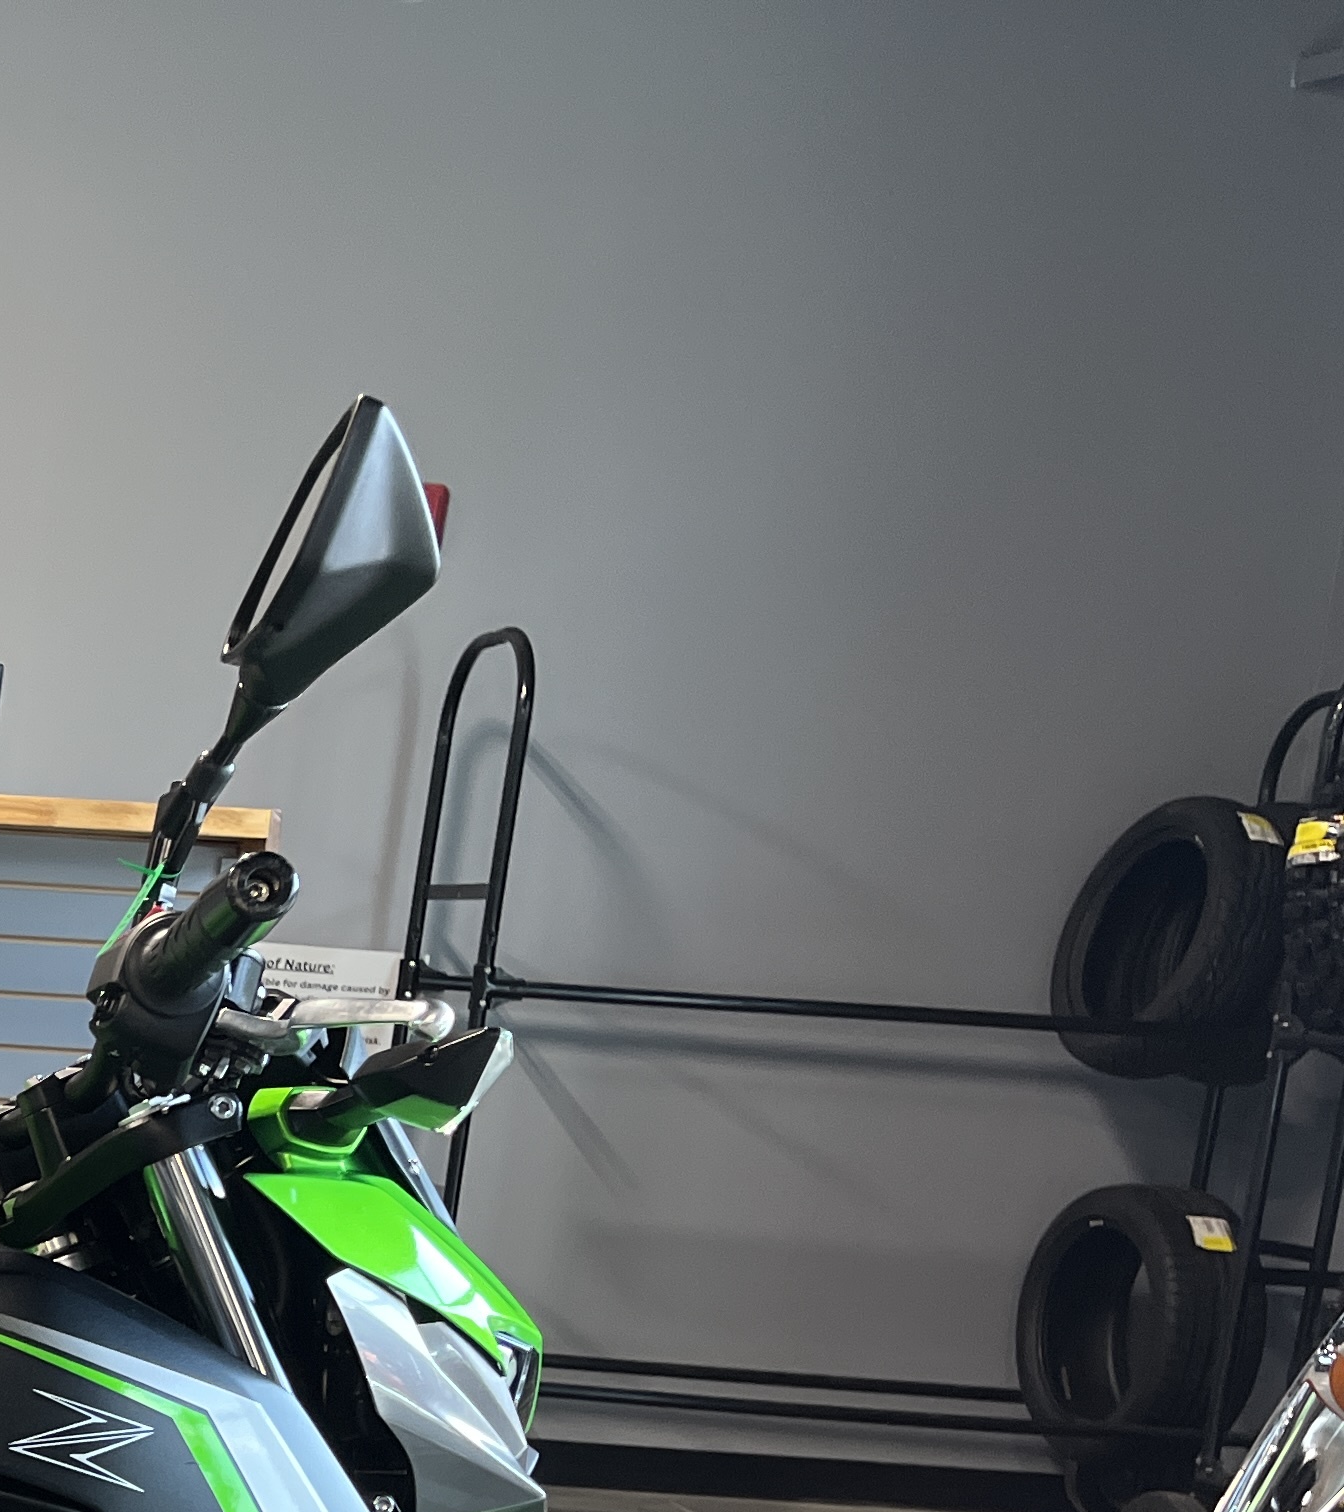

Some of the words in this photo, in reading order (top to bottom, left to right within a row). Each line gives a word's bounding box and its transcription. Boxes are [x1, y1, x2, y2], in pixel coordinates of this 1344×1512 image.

[266, 957, 282, 970] of
[283, 978, 297, 988] for
[299, 980, 339, 992] damage
[340, 984, 377, 994] caused
[378, 986, 391, 996] by
